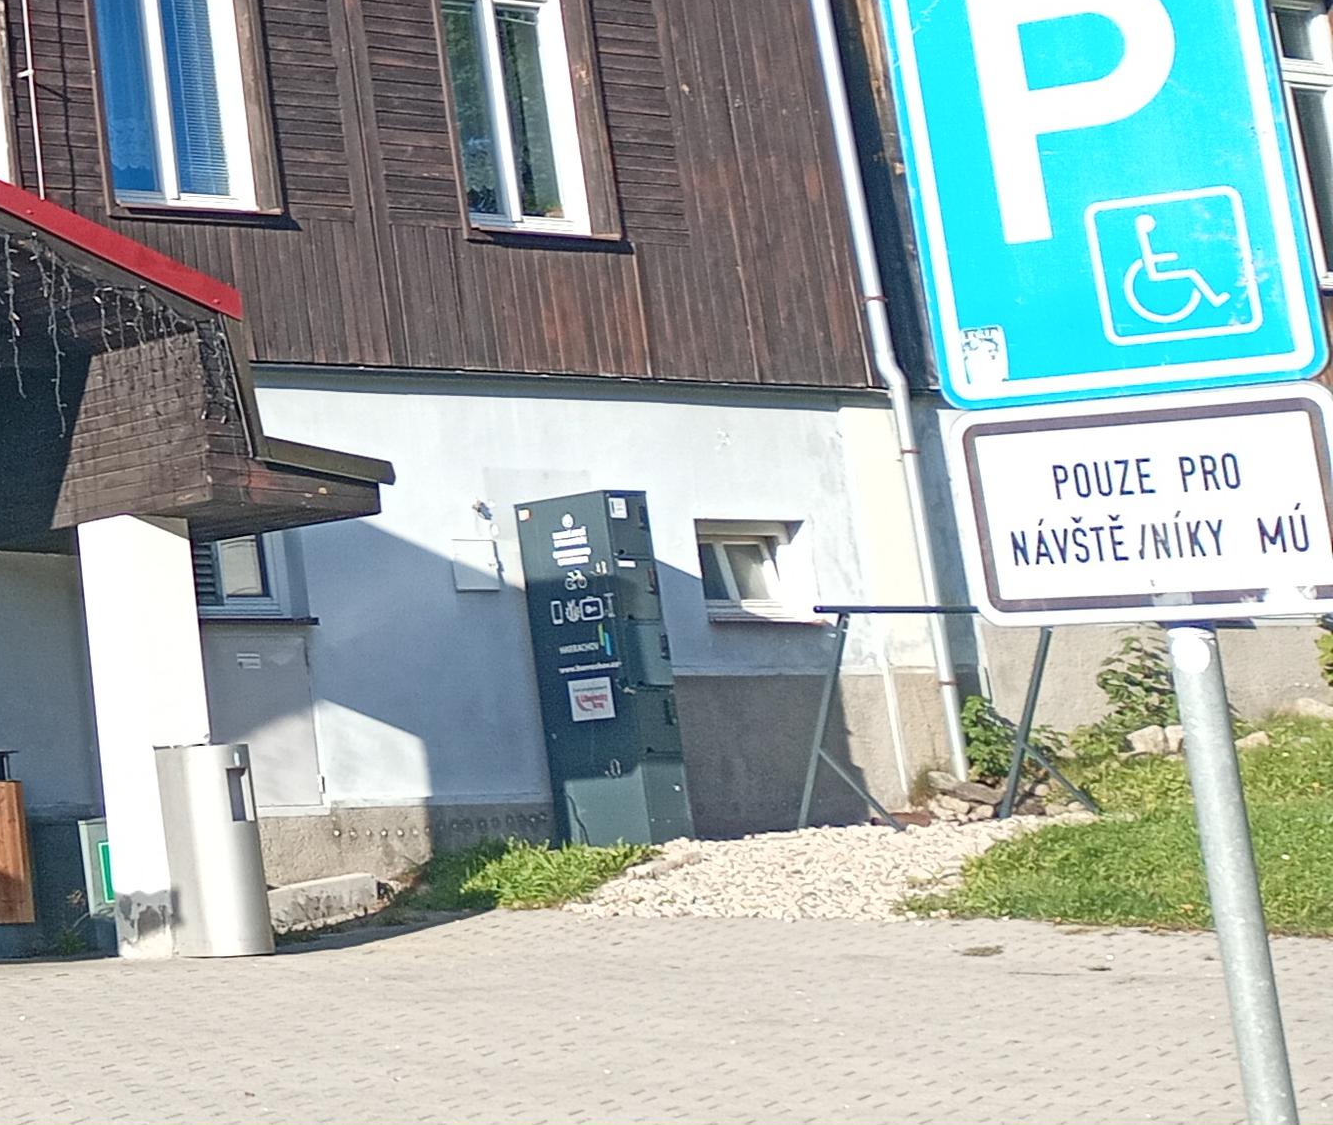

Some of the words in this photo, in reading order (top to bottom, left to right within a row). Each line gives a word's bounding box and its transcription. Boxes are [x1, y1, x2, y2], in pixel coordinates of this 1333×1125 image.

[1052, 457, 1156, 500] POUZE
[1178, 453, 1241, 492] PRO
[1257, 502, 1310, 554] MÚ
